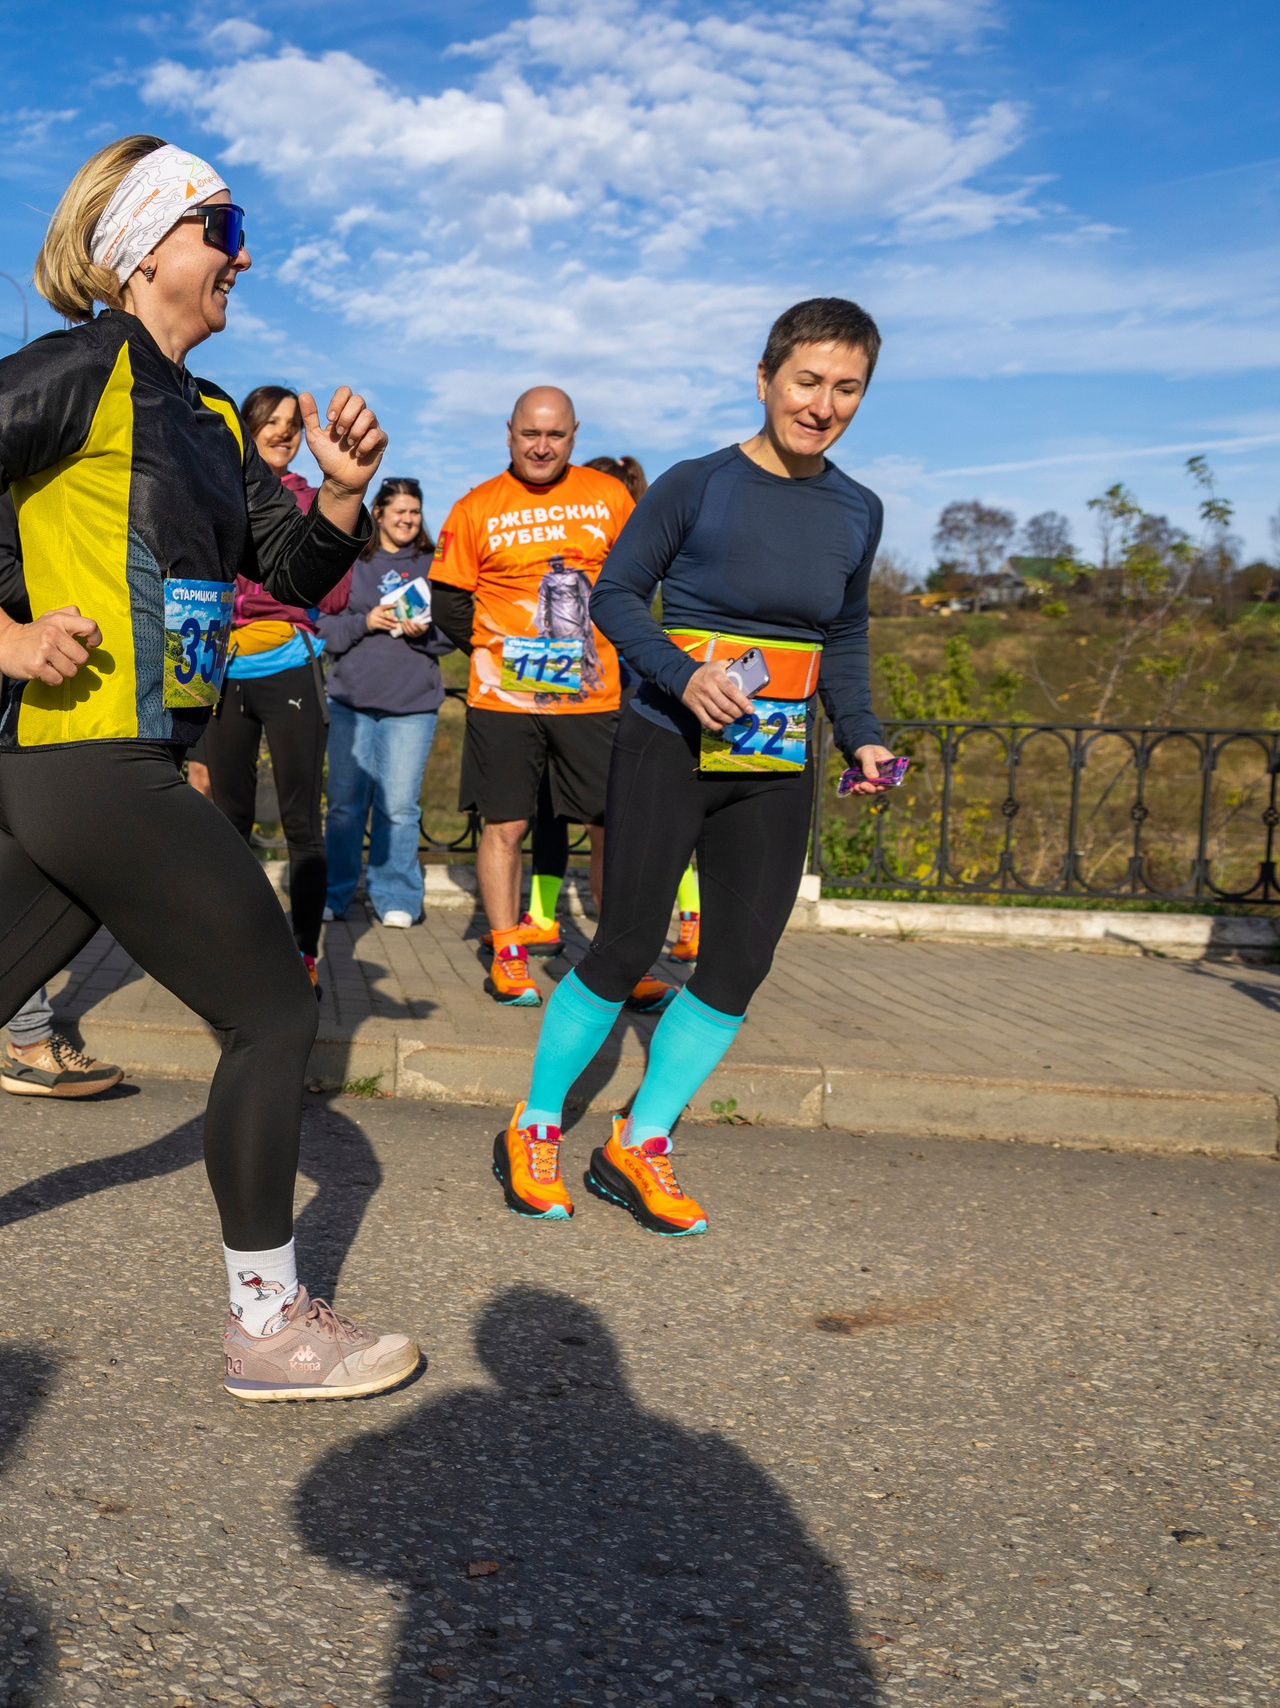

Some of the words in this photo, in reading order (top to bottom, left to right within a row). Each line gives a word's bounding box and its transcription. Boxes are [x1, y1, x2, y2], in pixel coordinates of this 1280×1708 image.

[133, 188, 160, 218] CODE
[487, 500, 610, 533] РЖЕВСКИЙ
[488, 524, 567, 552] РУБЕЖ
[172, 587, 218, 603] СТАРИЦКИЕ
[513, 653, 573, 683] 112
[729, 711, 788, 756] 22
[624, 1158, 653, 1197] CORDURA
[289, 1361, 321, 1374] Kappa
